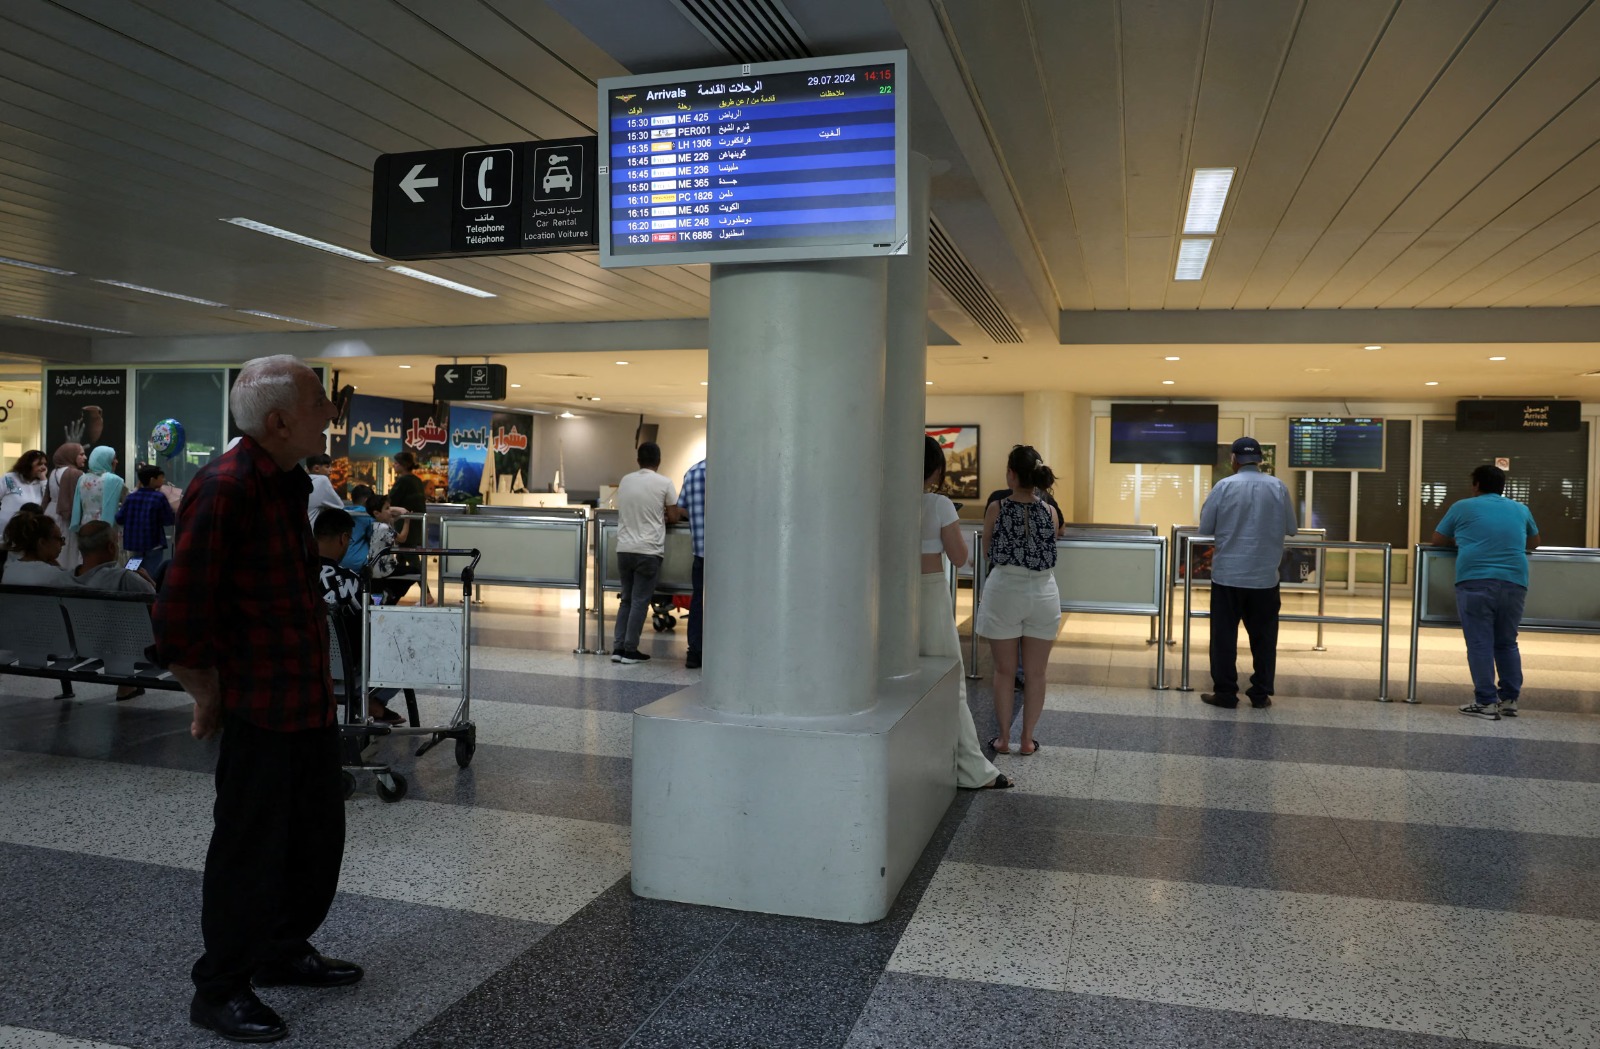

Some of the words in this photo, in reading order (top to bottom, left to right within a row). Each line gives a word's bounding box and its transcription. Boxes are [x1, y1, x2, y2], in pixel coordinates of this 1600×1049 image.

[808, 74, 855, 86] 29.07.2024
[864, 70, 891, 80] 14:15
[698, 84, 725, 95] القادمة
[728, 81, 762, 93] الرحلات
[646, 88, 686, 101] Arrivals
[718, 110, 742, 120] الرياض
[627, 119, 648, 128] 15:30
[678, 115, 691, 123] ME
[694, 114, 708, 122] 425
[628, 132, 648, 140] 15:30
[678, 126, 711, 136] PER001
[719, 123, 734, 134] الشيخ
[736, 123, 750, 133] شرم
[628, 144, 648, 153] 15:35
[678, 142, 690, 150] LH
[693, 139, 711, 148] 1306
[719, 136, 752, 147] فرانكفورت
[628, 157, 648, 166] 15:45
[678, 154, 691, 162] ME
[694, 152, 709, 161] 226
[628, 170, 648, 179] 15:45
[628, 183, 648, 192] 15:50
[678, 180, 691, 188] ME
[694, 179, 709, 187] 365
[628, 196, 648, 204] 16:10
[678, 193, 691, 201] PC
[694, 191, 713, 200] 1826
[557, 206, 583, 215] سيارات
[628, 209, 648, 217] 16:15
[678, 206, 692, 214] ME
[694, 205, 709, 213] 405
[719, 202, 740, 212] الكويت
[474, 214, 494, 222] هاتف
[532, 208, 555, 218] للايجار
[552, 218, 577, 226] Rental
[628, 221, 649, 230] 16:20
[678, 219, 692, 227] ME
[694, 218, 709, 226] 248
[466, 224, 505, 234] Telephone
[466, 235, 504, 245] Téléphone
[524, 231, 555, 240] Location
[558, 230, 588, 238] Voitures
[628, 234, 649, 243] 16:30
[679, 232, 690, 240] TK
[693, 230, 712, 239] 6886
[55, 376, 77, 387] للتجارة
[77, 375, 92, 386] مش
[93, 376, 120, 387] الحضارة
[404, 416, 448, 451] مشوار
[493, 424, 528, 455] مشوار
